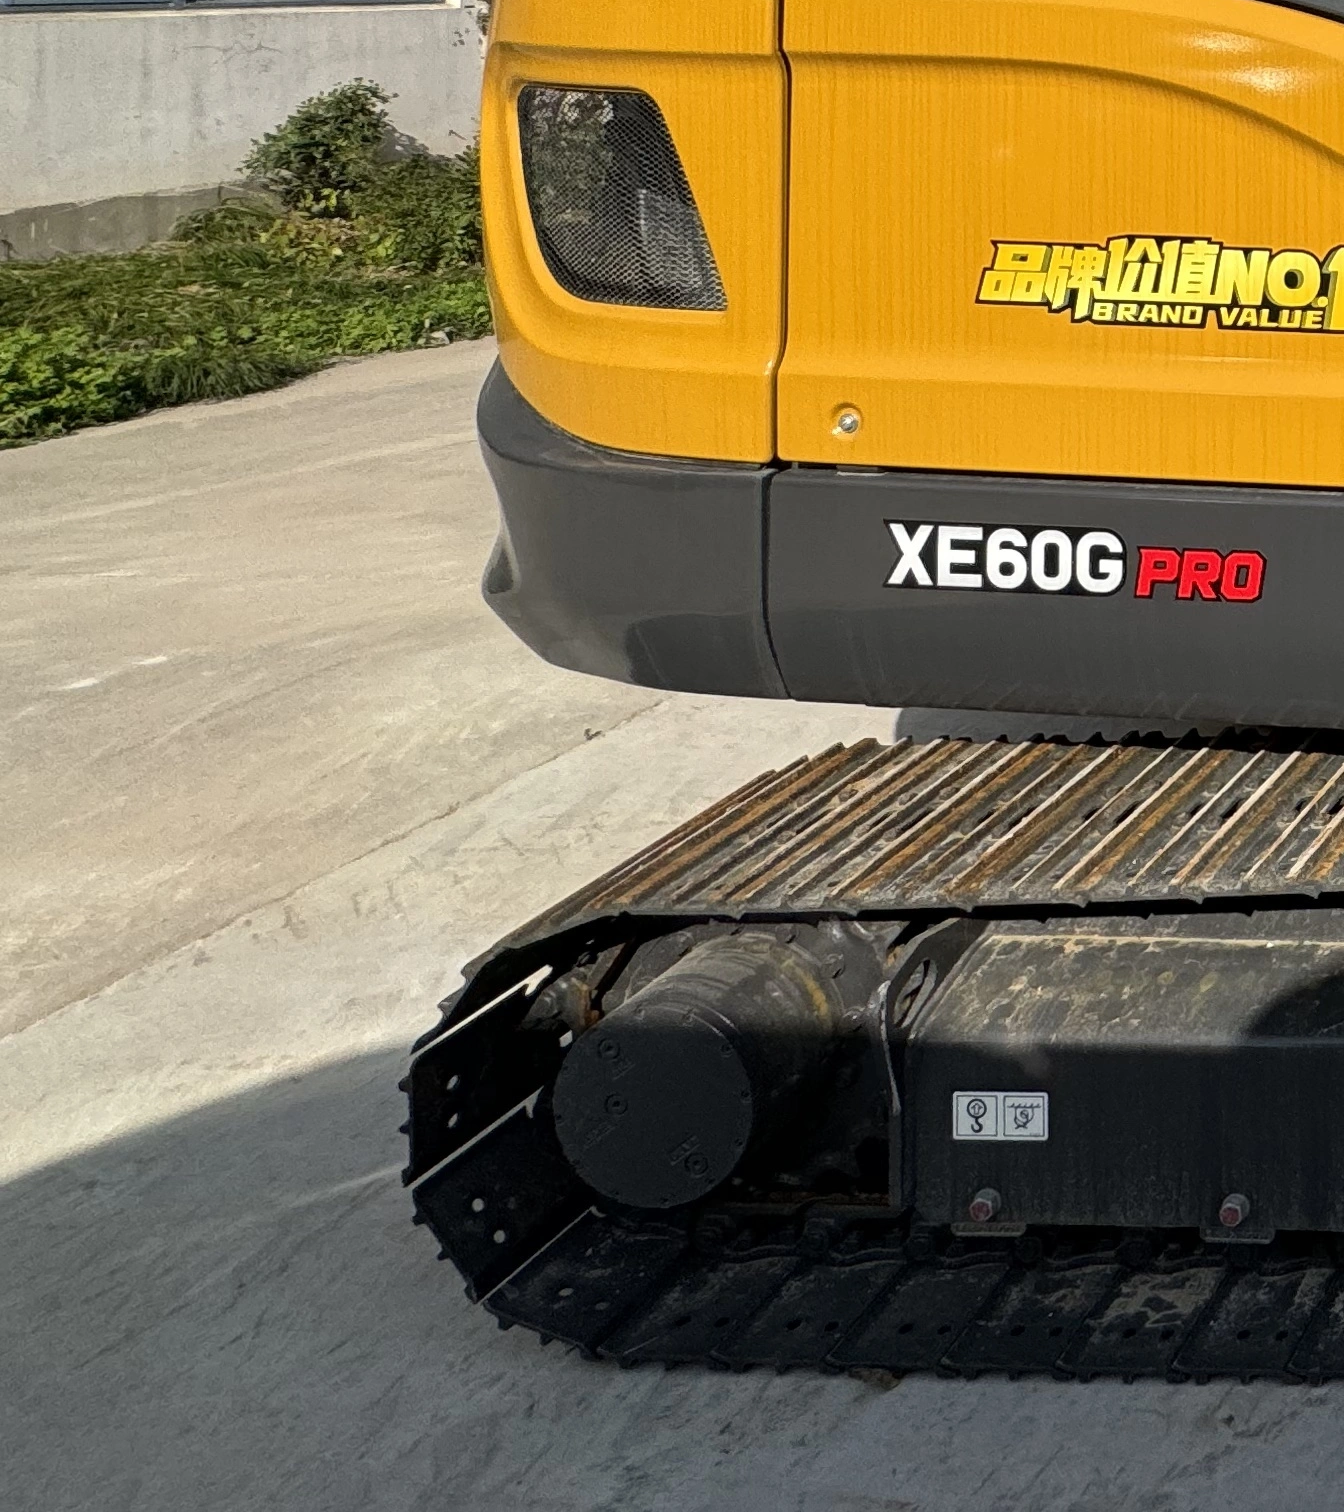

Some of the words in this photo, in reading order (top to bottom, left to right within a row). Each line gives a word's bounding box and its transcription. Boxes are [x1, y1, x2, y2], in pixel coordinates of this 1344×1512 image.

[1092, 302, 1203, 325] BRAND
[1219, 306, 1324, 329] VALUE
[886, 523, 1124, 594] XE60G
[1135, 548, 1264, 601] PRO
